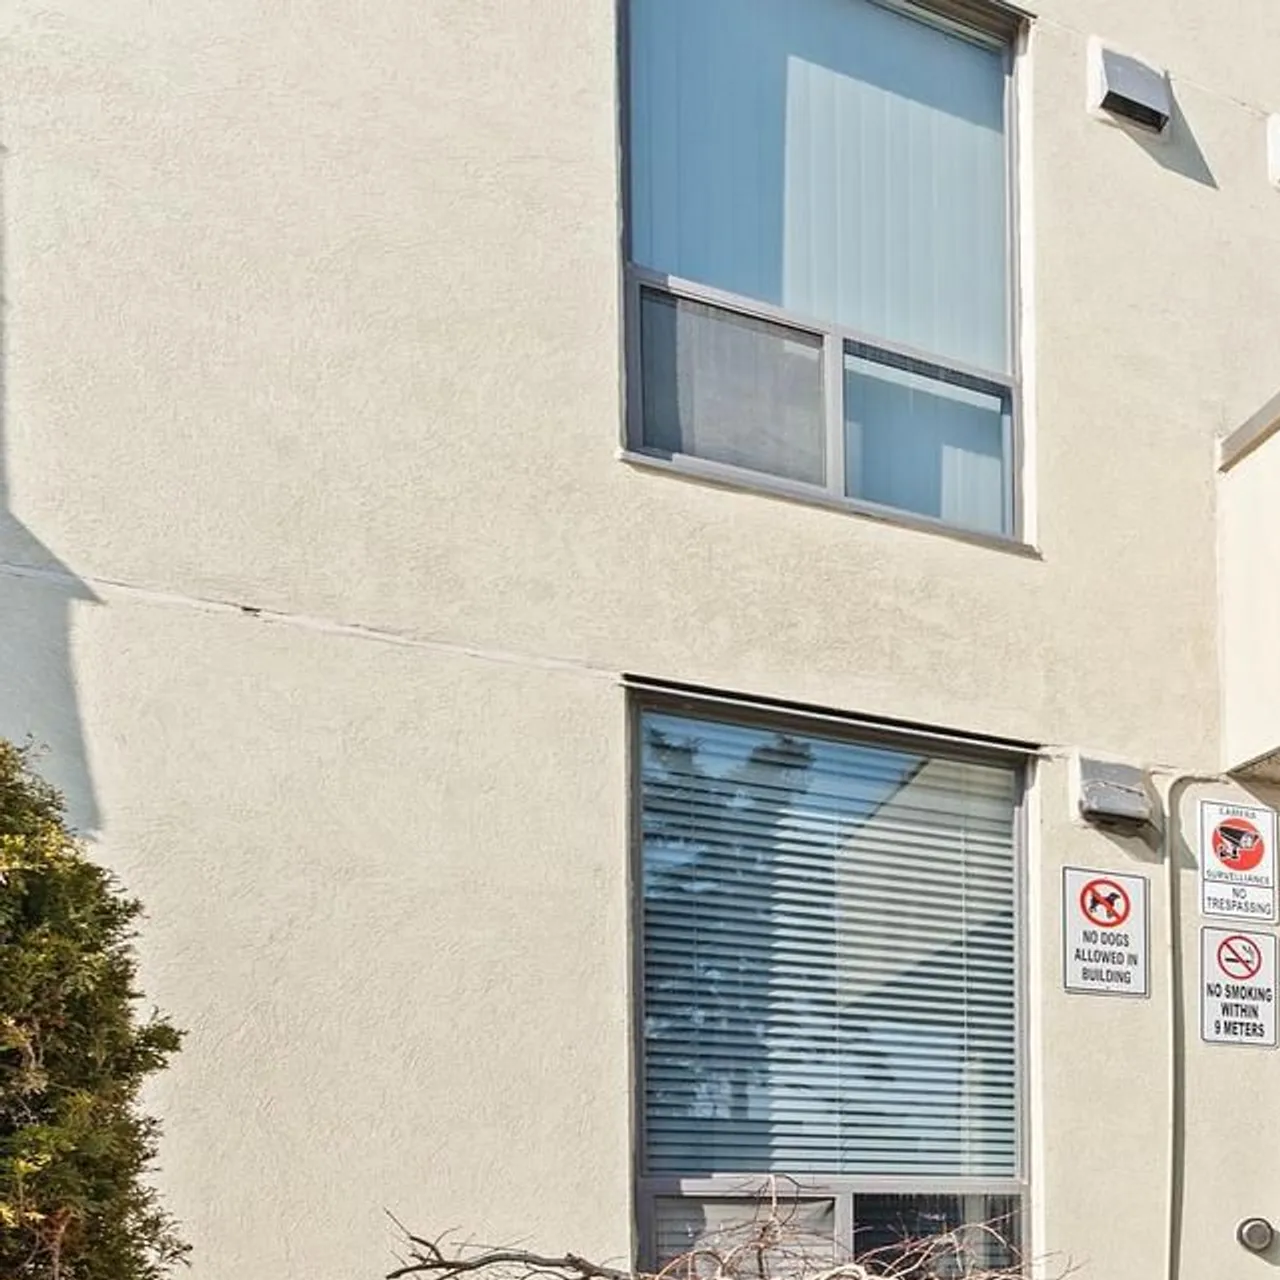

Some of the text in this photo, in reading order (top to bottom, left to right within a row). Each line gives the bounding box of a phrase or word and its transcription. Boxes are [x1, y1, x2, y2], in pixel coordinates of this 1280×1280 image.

[1232, 887, 1247, 900] NO
[1207, 896, 1271, 915] TRESPASSING
[1082, 930, 1130, 947] NO DOGS
[1074, 948, 1138, 966] ALLOWED IN
[1082, 967, 1131, 984] BUILDING
[1207, 983, 1272, 1002] NO SMOKING
[1221, 1002, 1259, 1019] WITHIN
[1214, 1020, 1265, 1037] 9 METERS
